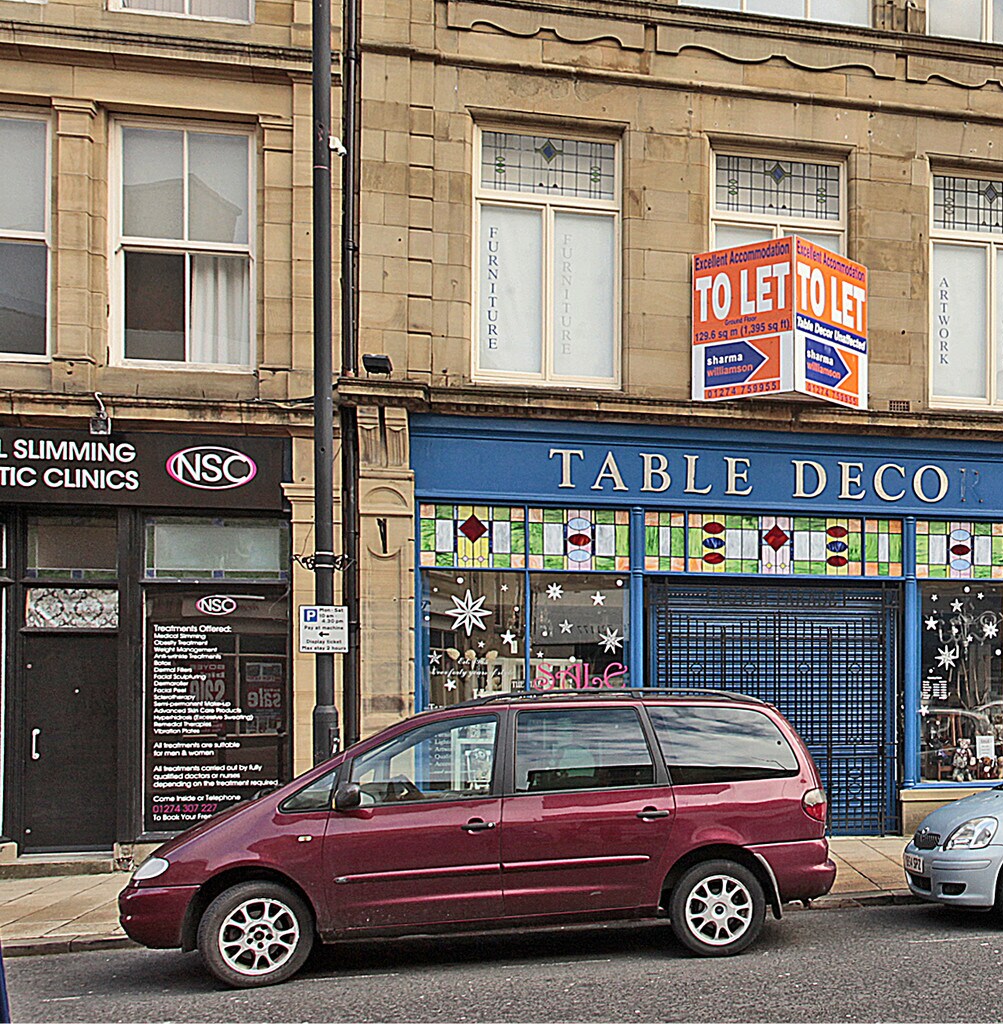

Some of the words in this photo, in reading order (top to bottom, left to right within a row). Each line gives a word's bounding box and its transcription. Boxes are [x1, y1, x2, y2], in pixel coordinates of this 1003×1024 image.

[695, 253, 728, 271] Excellent
[729, 242, 790, 265] Accommodation
[487, 227, 499, 349] FURNITURE
[562, 234, 572, 355] FURNITURE
[695, 272, 732, 322] TO
[740, 261, 790, 316] LET
[797, 261, 825, 317] TO
[830, 276, 866, 332] LET
[695, 330, 716, 341] 129.6
[718, 330, 728, 339] sq
[730, 328, 738, 336] m
[768, 322, 778, 332] sq
[780, 318, 790, 330] ft)
[938, 277, 950, 365] ARTWORK
[707, 353, 743, 366] sharma
[806, 349, 834, 366] sharma
[707, 364, 754, 377] williamson
[807, 361, 841, 379] williamson
[707, 387, 737, 398] 01274
[741, 381, 777, 395] 759955
[13, 439, 136, 463] SLIMMING
[176, 453, 249, 483] NSC
[549, 448, 753, 496] TABLE
[43, 468, 139, 491] CLINICS
[201, 598, 234, 613] NSC
[306, 609, 317, 622] P
[153, 624, 198, 633] Treatments
[533, 662, 628, 691] SALE
[239, 764, 248, 772] by
[153, 780, 192, 788] depending
[152, 804, 181, 813] 01274
[183, 804, 199, 813] 307
[201, 803, 218, 812] 227
[205, 794, 241, 802] Telephone
